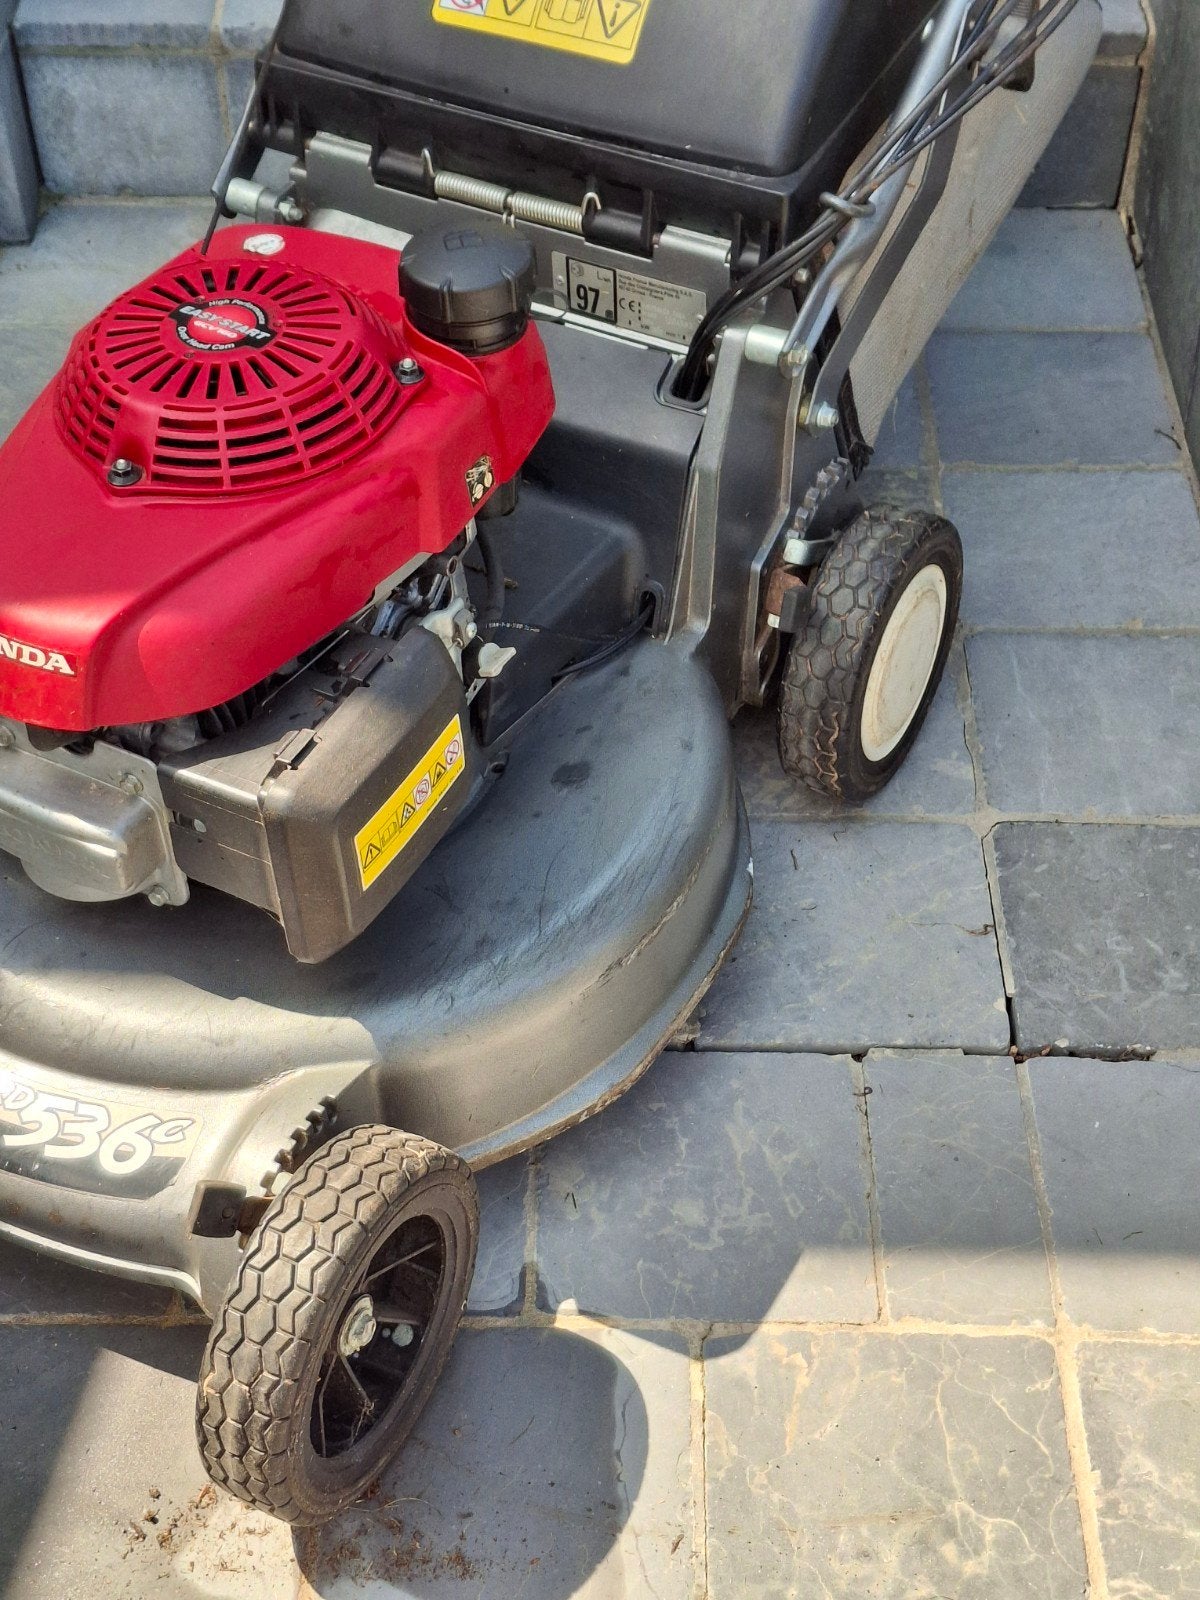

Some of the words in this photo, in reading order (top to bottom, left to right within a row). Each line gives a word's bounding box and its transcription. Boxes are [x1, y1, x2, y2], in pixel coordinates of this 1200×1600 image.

[576, 283, 600, 314] 97
[179, 305, 221, 321] EASY
[219, 319, 270, 339] START
